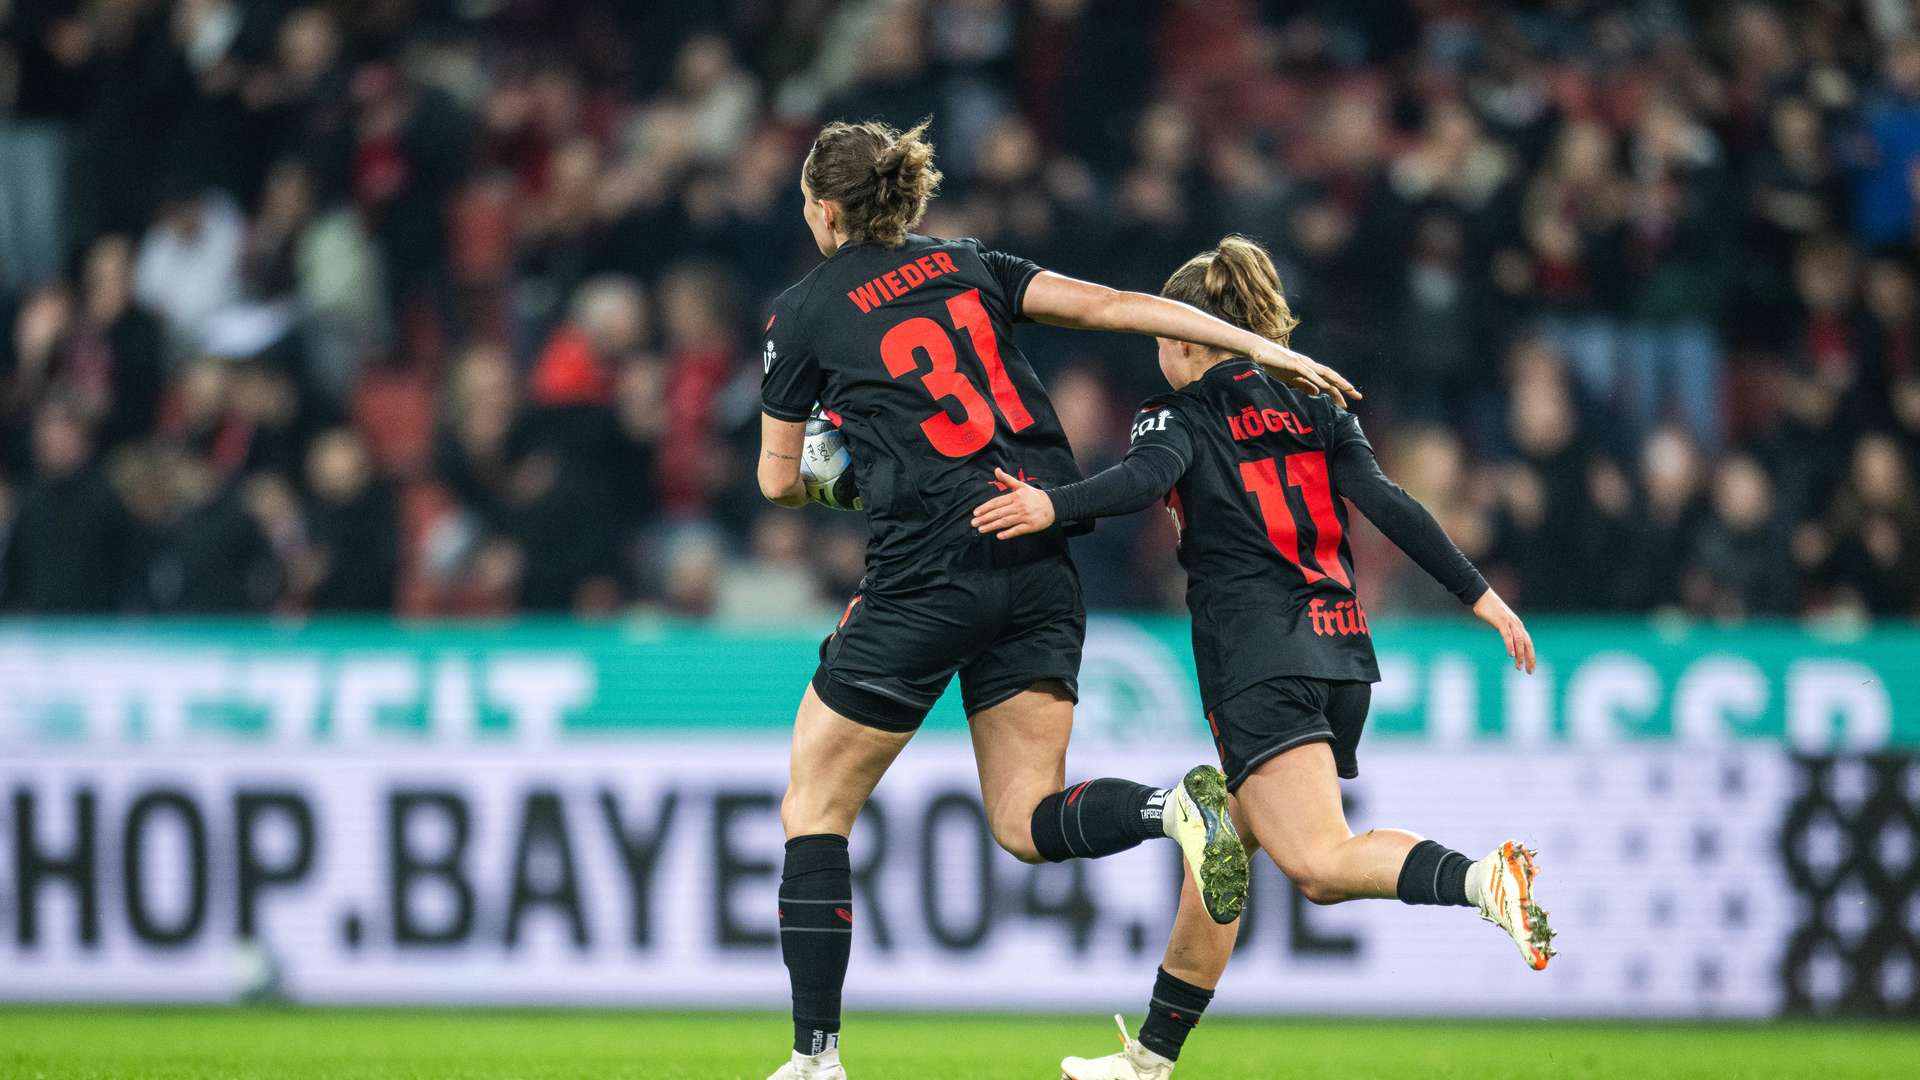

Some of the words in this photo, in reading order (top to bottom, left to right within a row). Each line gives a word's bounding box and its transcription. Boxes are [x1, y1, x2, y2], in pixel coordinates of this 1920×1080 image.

[848, 251, 960, 314] WIEDER
[880, 288, 1035, 459] 31
[1227, 405, 1313, 441] KÖGEL
[1239, 451, 1352, 592] 11
